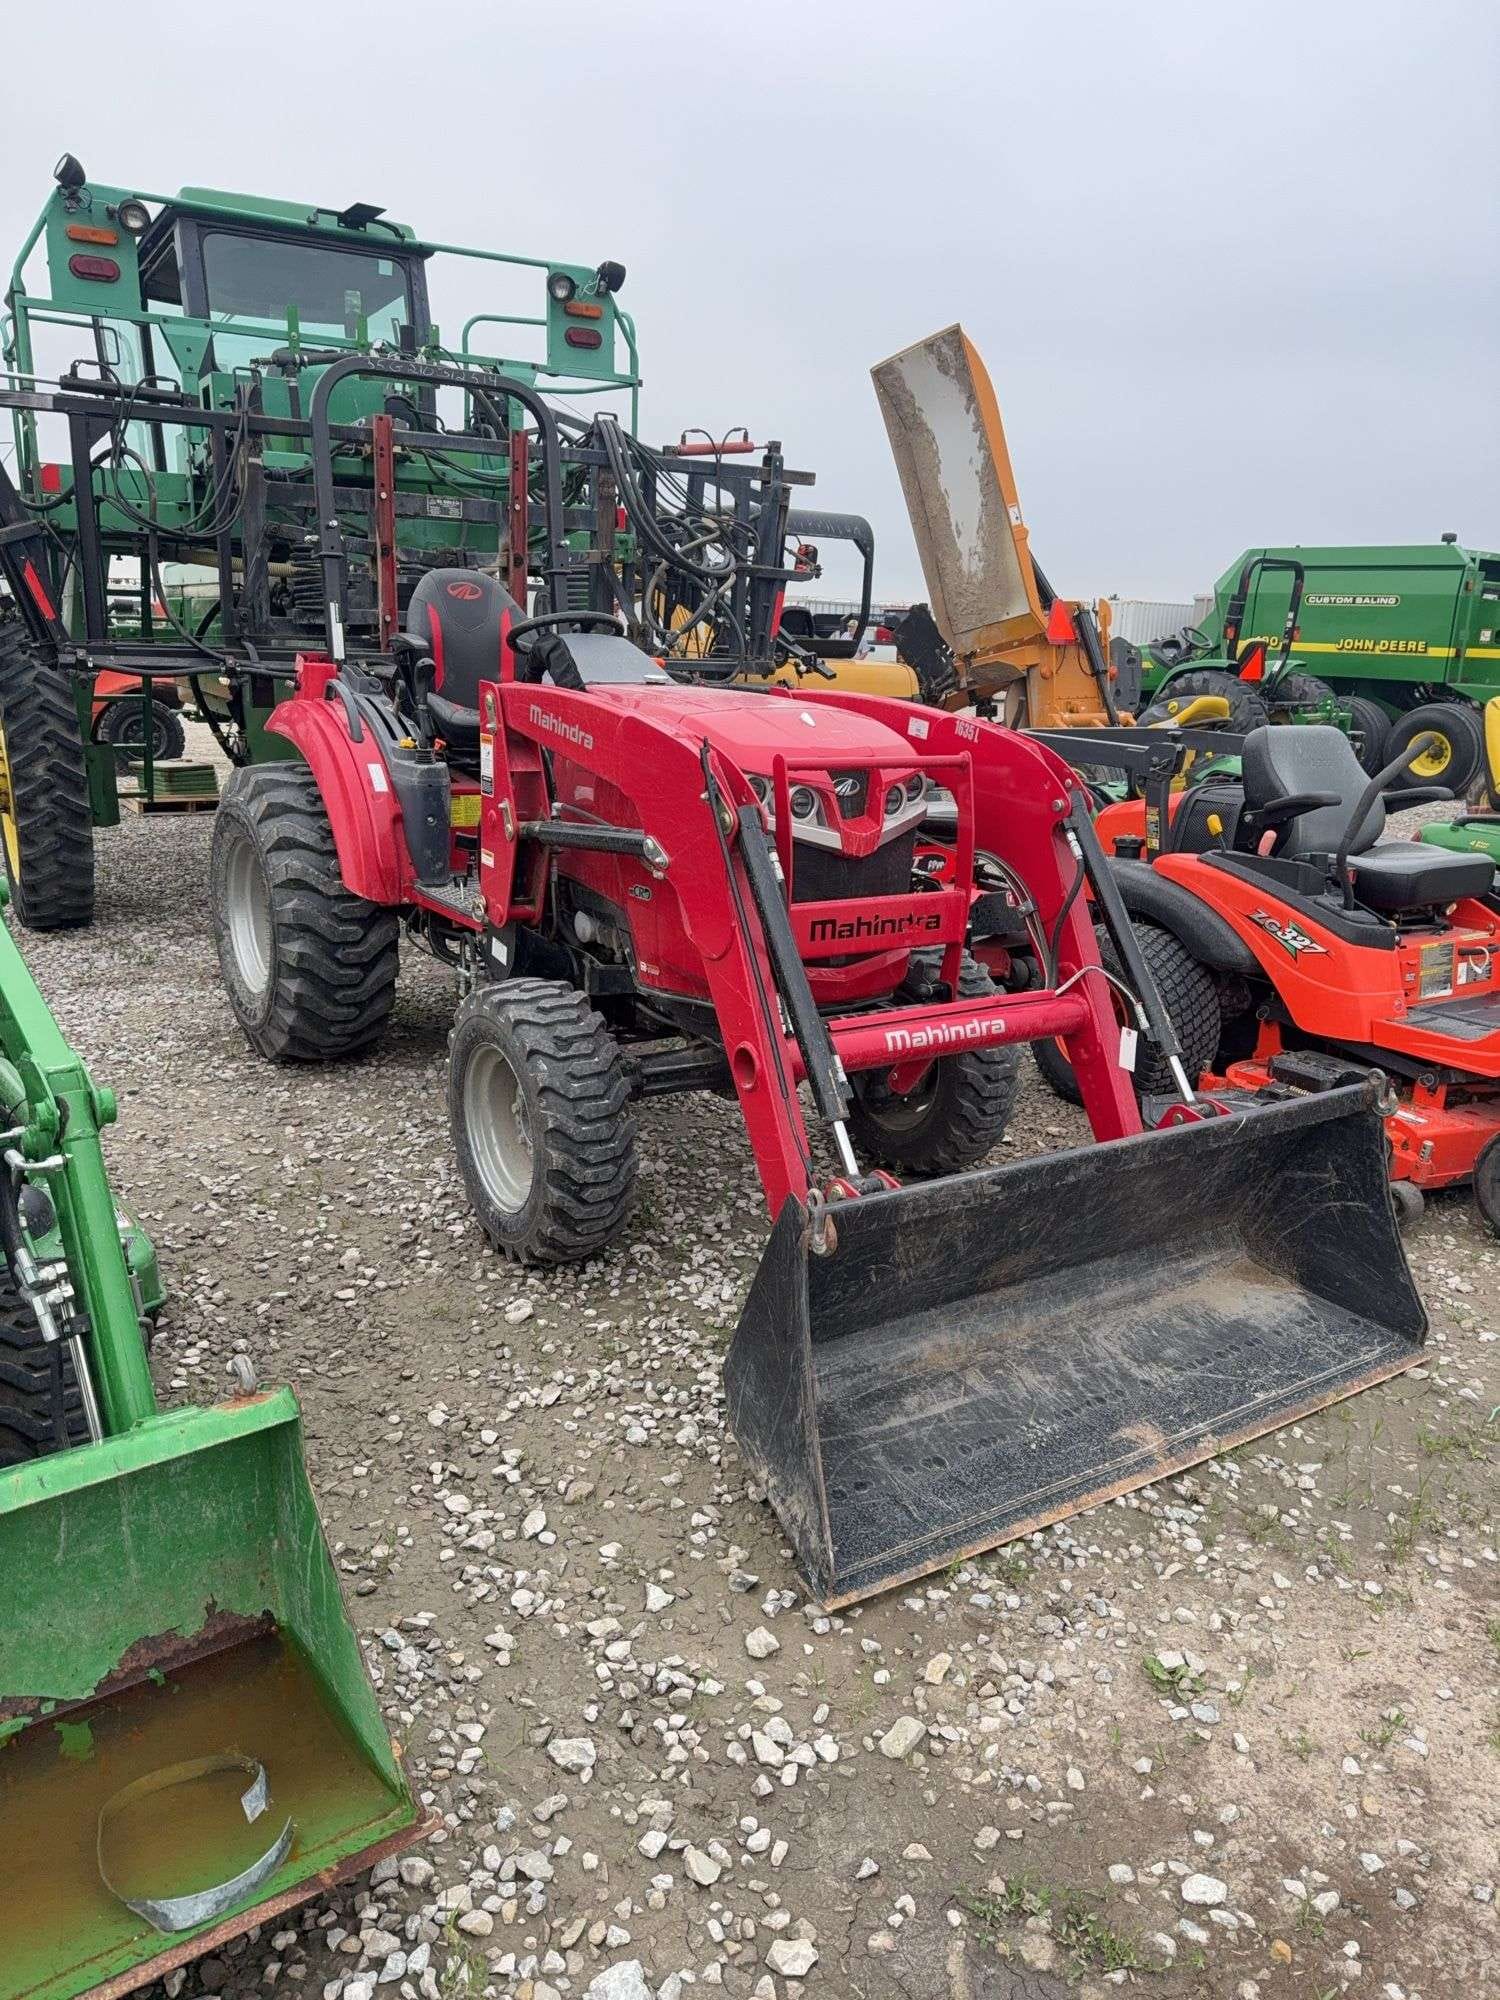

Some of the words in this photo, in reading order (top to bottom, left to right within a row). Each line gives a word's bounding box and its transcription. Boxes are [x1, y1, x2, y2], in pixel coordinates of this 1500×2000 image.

[1308, 596, 1353, 604] CUSTOM
[1355, 596, 1397, 604] BALING
[1336, 639, 1375, 650] JOHN
[1379, 640, 1427, 653] DEERE
[529, 704, 593, 750] Mahindra
[885, 1018, 1006, 1052] Mahindra
